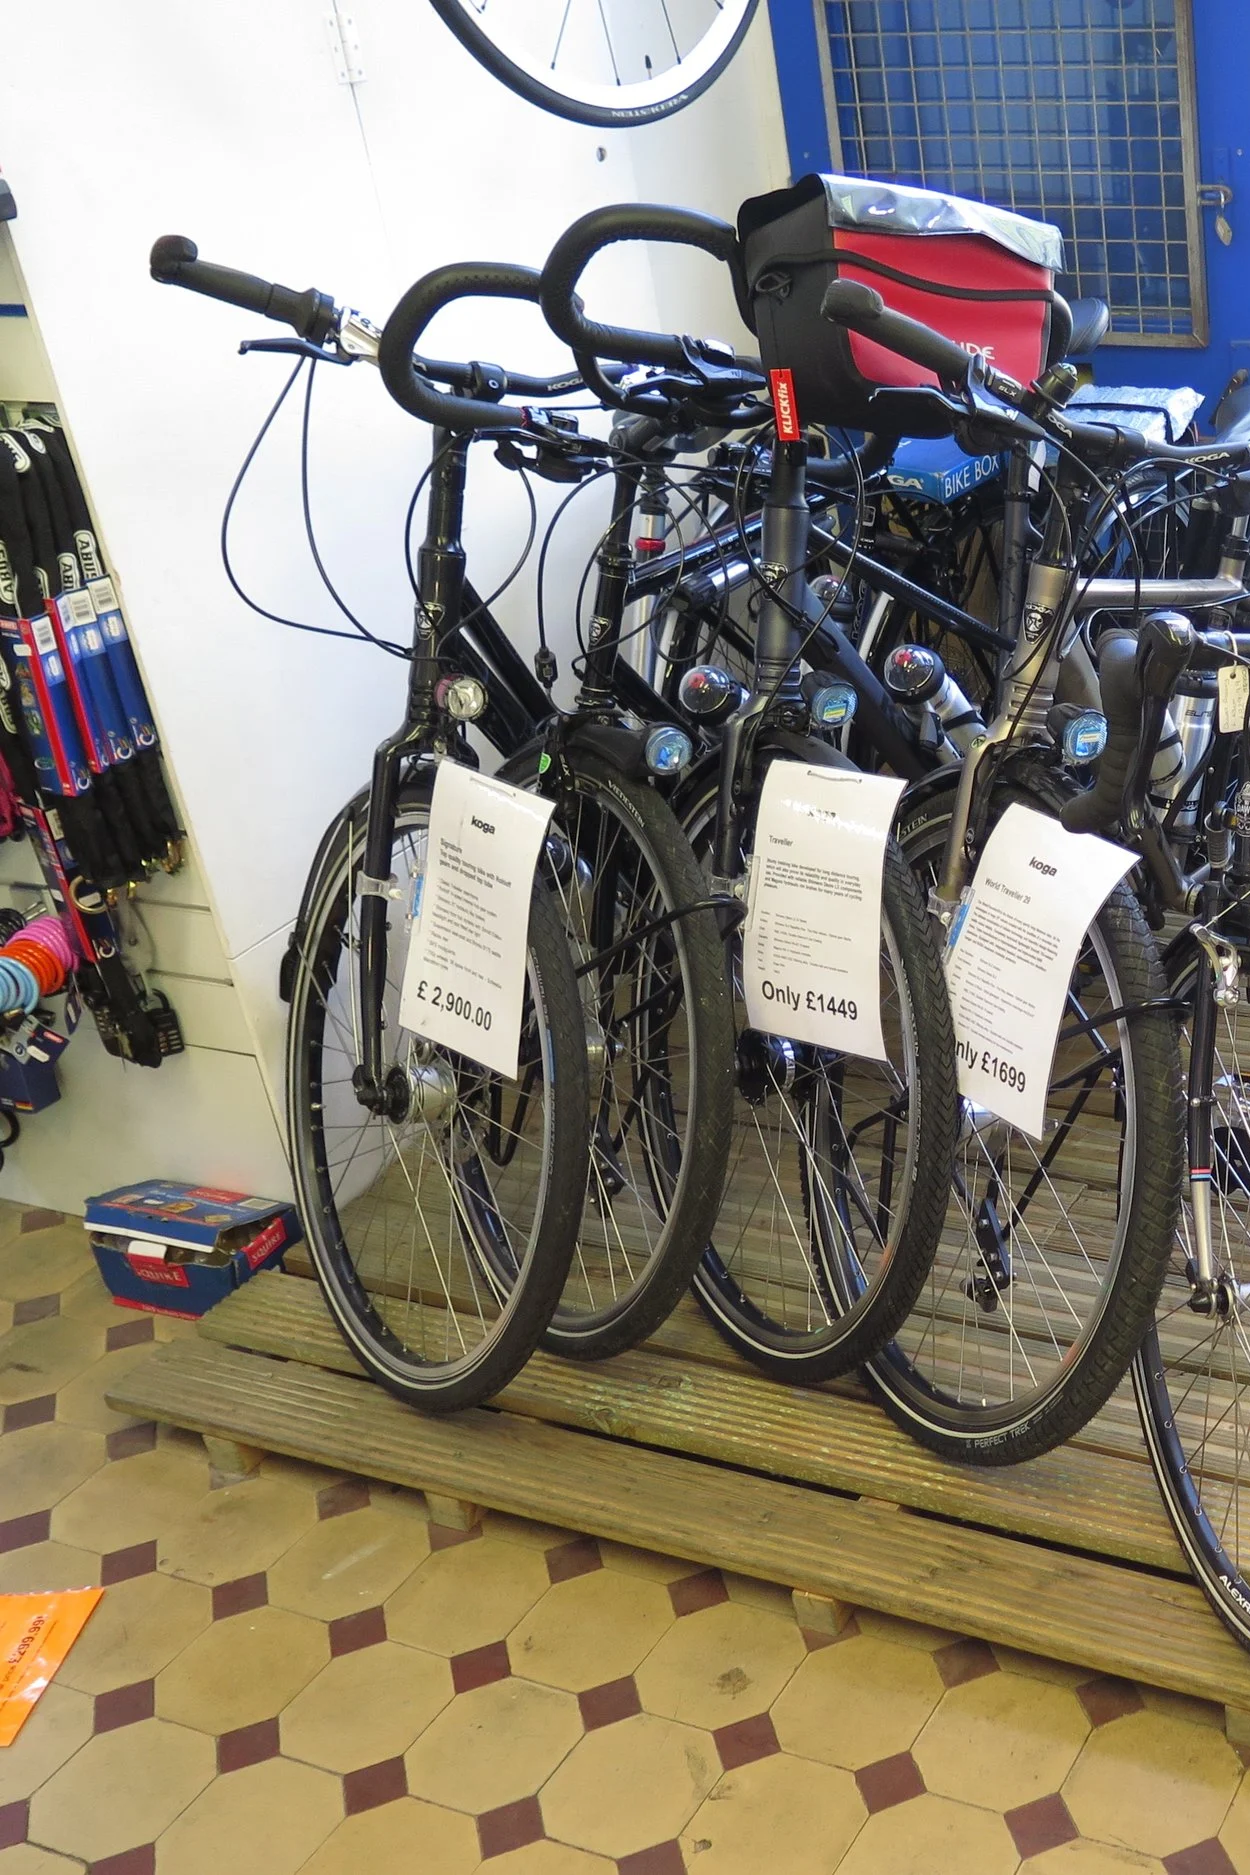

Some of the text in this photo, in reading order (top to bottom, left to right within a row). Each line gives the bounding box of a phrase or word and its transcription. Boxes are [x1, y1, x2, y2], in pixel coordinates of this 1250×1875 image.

[1047, 413, 1074, 439] OGA
[944, 453, 999, 499] BIKE BOX
[471, 814, 496, 835] koga
[768, 834, 793, 848] Traveller
[1029, 856, 1058, 878] koga
[984, 878, 1001, 891] World
[1001, 884, 1024, 902] Traveller
[417, 980, 493, 1031] £ 2,900.00
[762, 980, 858, 1021] Only £1449
[954, 1040, 1026, 1093] nly £1699
[251, 1232, 281, 1262] SQUIRE
[974, 1421, 1032, 1449] PERFECT TREK
